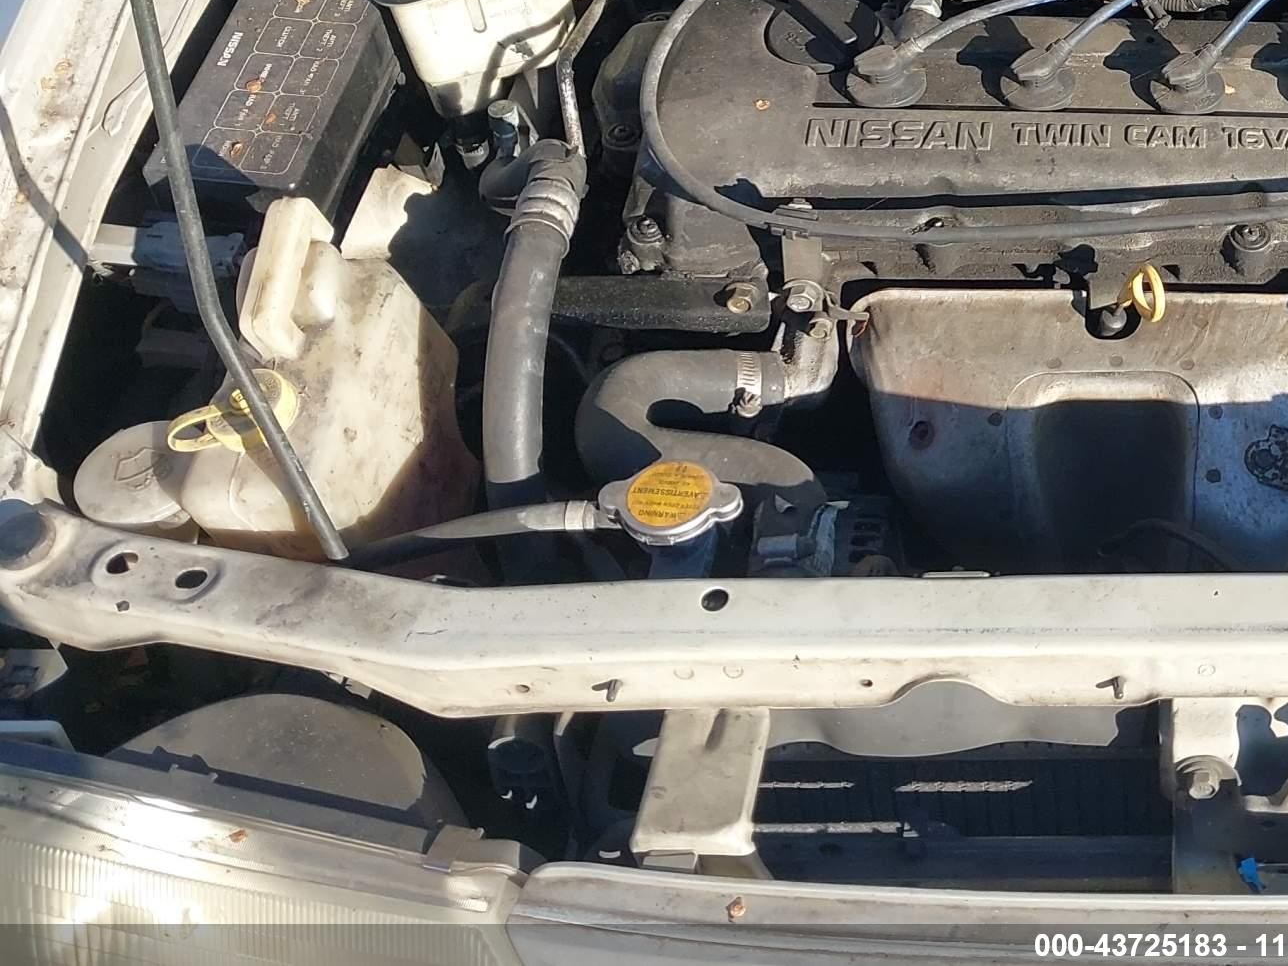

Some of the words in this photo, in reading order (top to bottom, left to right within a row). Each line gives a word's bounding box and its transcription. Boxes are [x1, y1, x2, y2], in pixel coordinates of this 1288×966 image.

[216, 31, 244, 67] NISSAN
[803, 117, 994, 151] NISSAN
[1010, 121, 1112, 148] TWIN
[1122, 122, 1207, 149] CAM
[638, 510, 678, 520] WARNING
